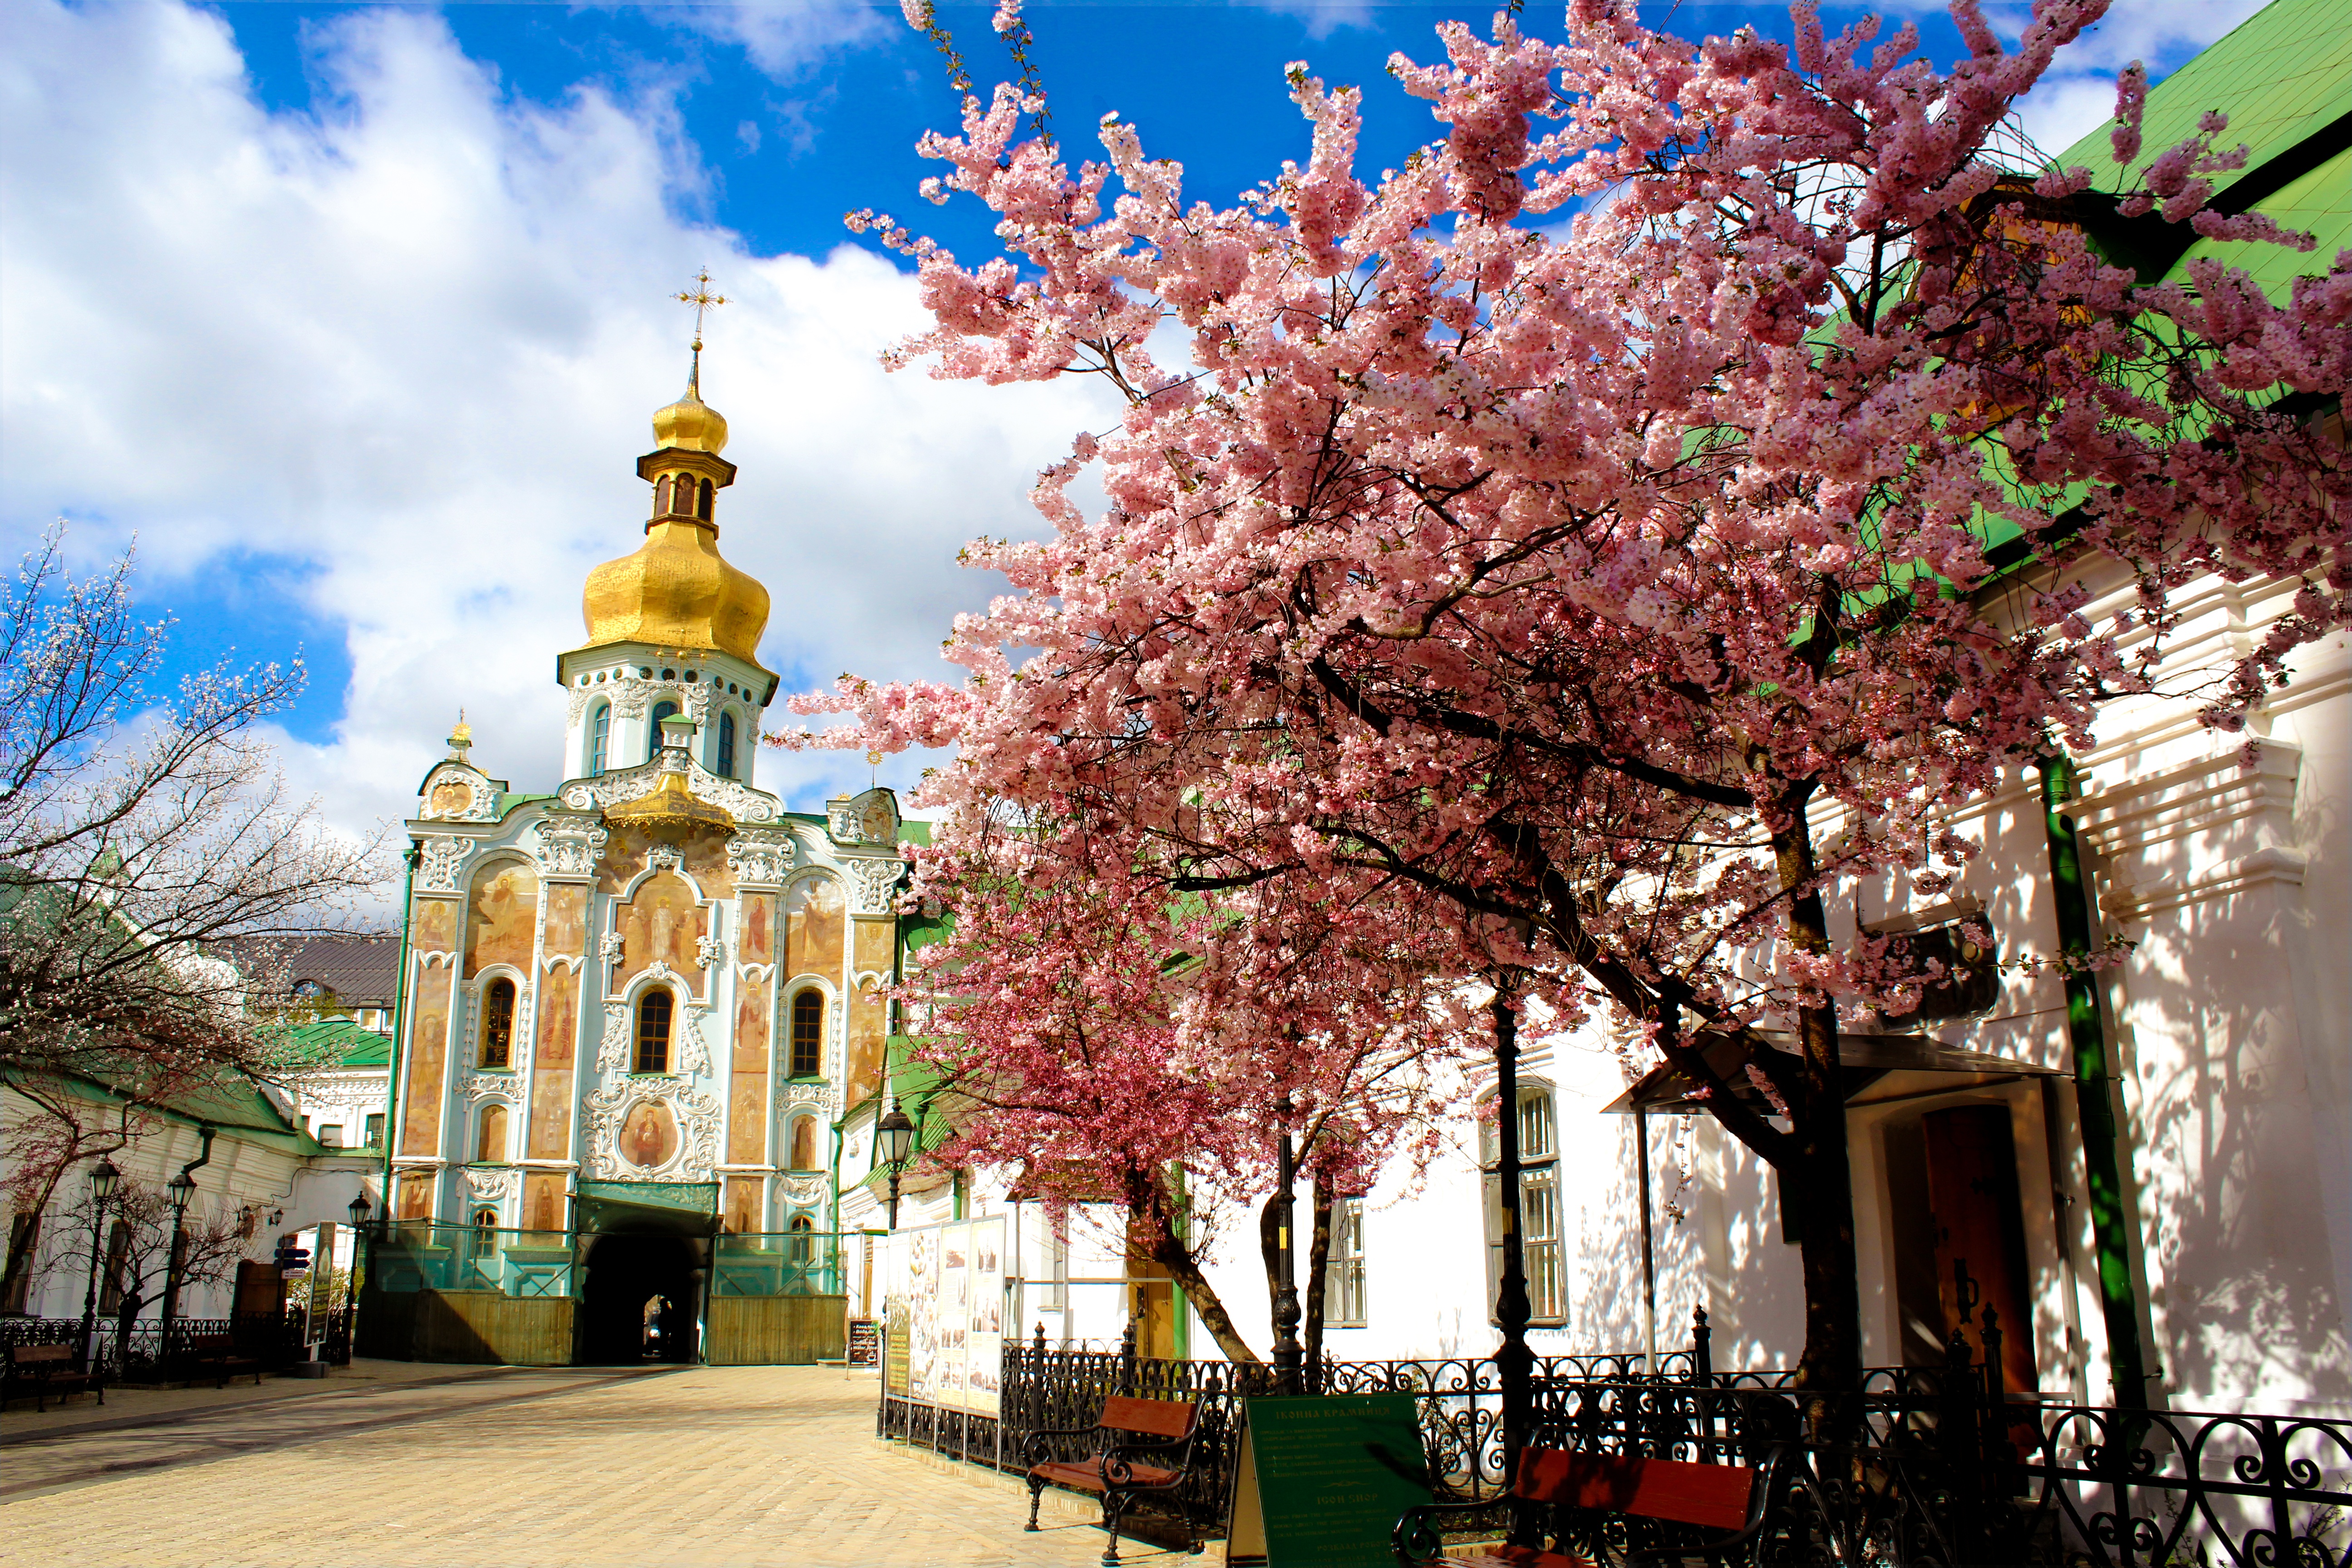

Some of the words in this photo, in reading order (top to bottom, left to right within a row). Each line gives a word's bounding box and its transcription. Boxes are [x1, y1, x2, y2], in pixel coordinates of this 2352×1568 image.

[1323, 1406, 1390, 1417] КРАМНИЦЯ
[1317, 1495, 1345, 1504] ICON
[1348, 1493, 1378, 1503] SHOP
